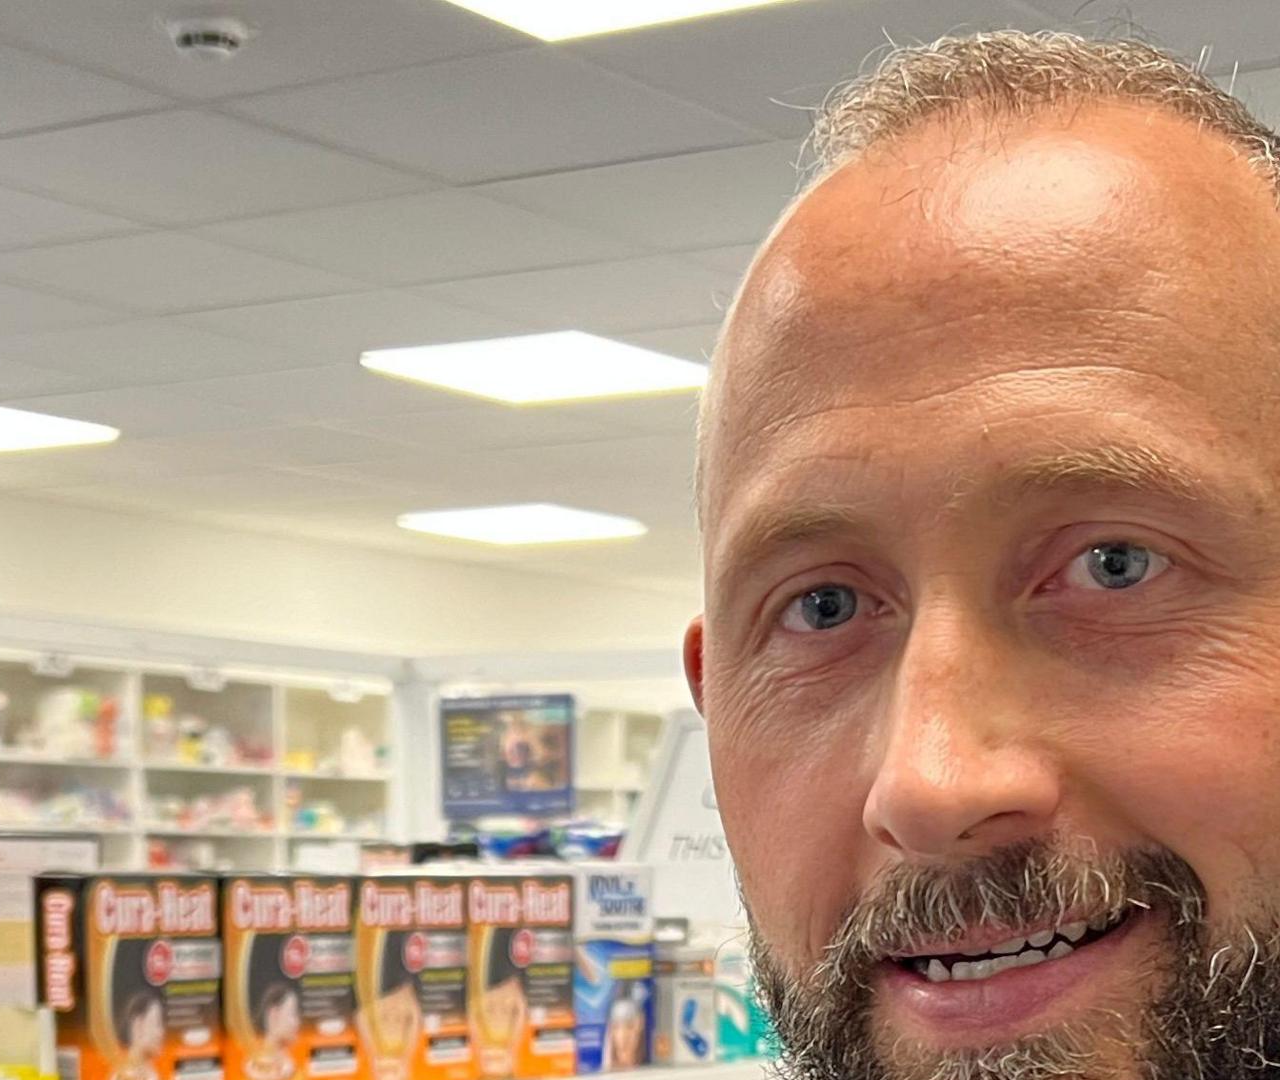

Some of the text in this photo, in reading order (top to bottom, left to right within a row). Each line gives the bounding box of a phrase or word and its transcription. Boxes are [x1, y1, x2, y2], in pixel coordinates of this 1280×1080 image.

[96, 880, 215, 934] Cura-Heat
[233, 880, 351, 930] Cura-Heat
[360, 880, 463, 925] Cura-Heat
[470, 879, 570, 923] Cura-Heat
